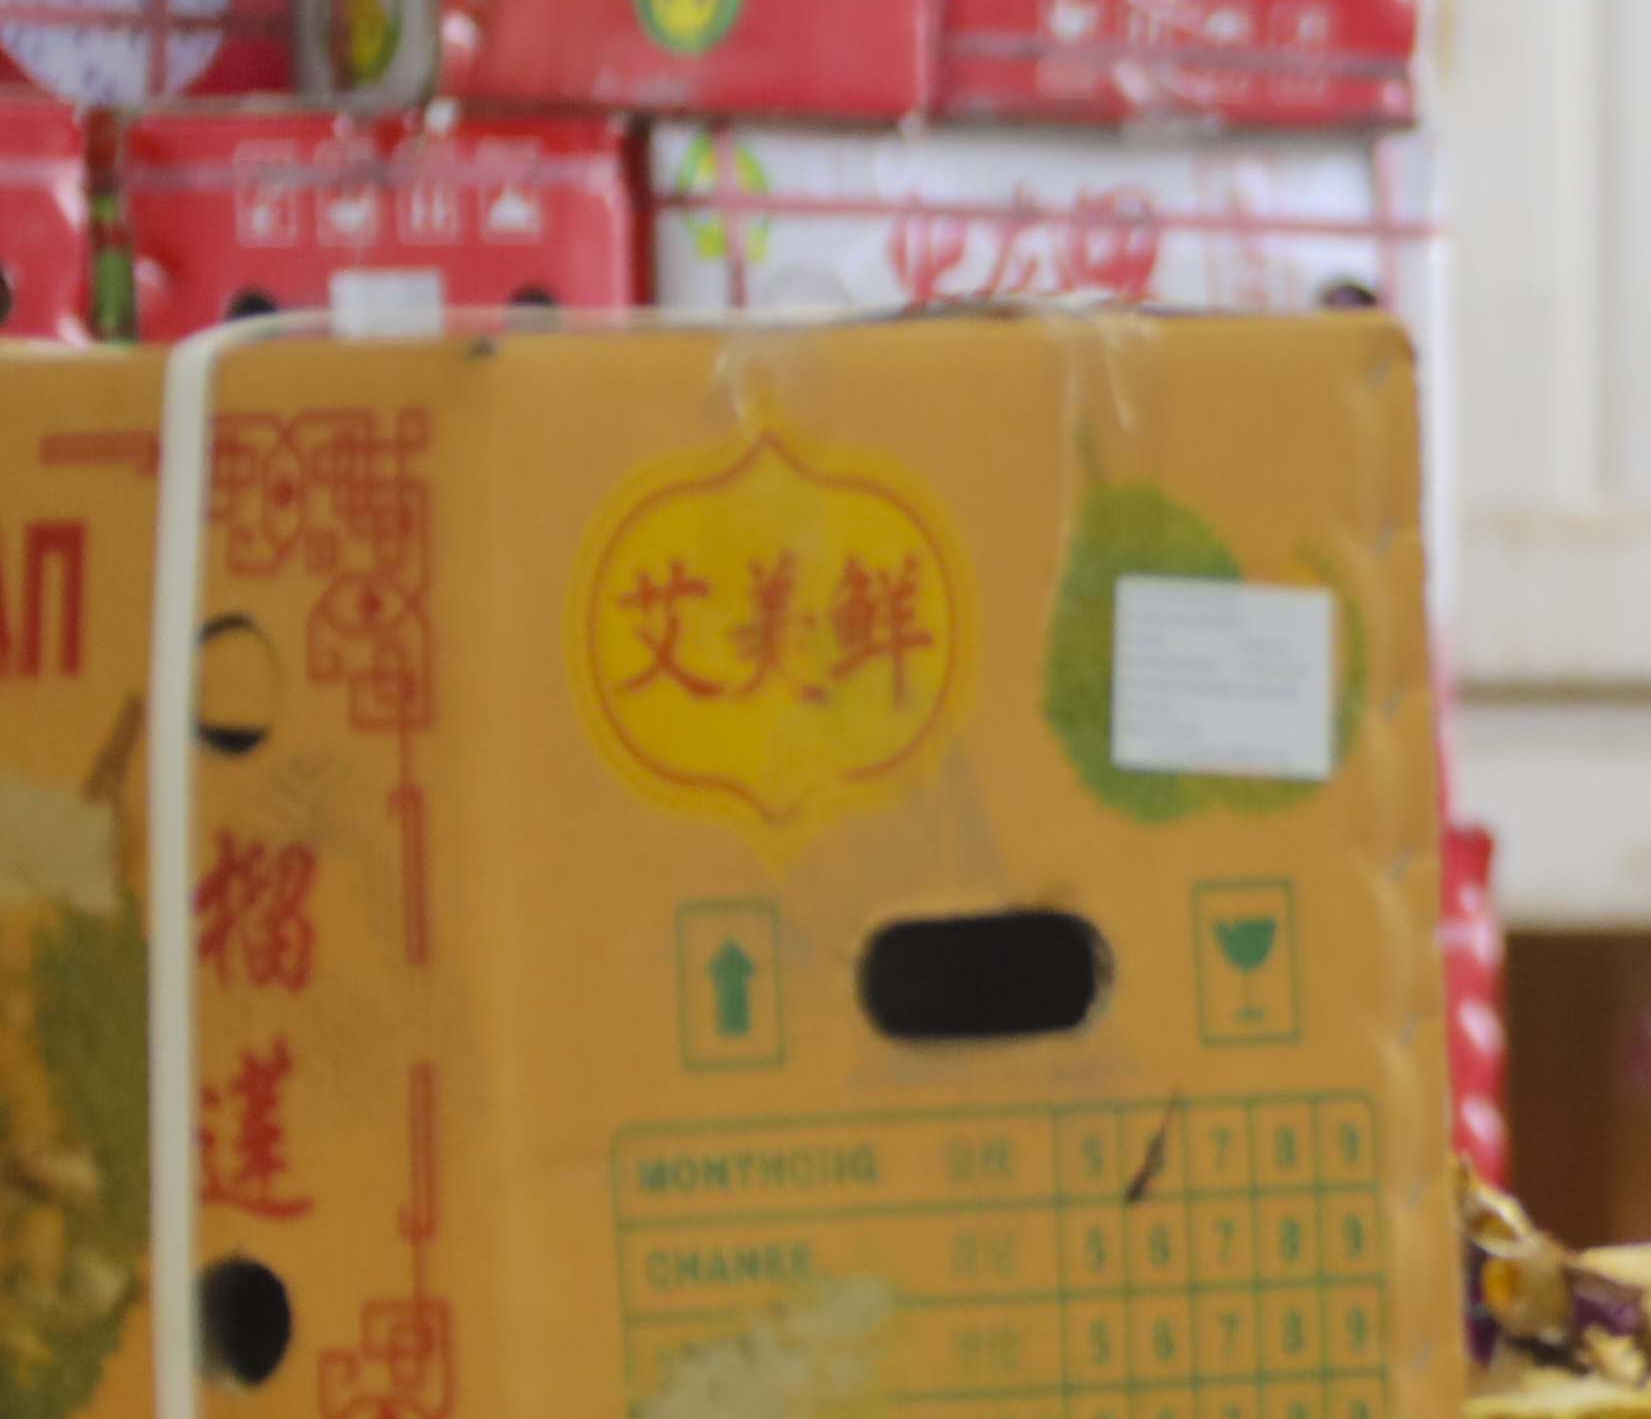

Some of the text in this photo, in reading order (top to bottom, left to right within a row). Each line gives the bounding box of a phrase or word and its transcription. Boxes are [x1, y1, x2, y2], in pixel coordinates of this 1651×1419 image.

[1084, 1133, 1103, 1177] 5
[1211, 1125, 1229, 1171] 7
[1275, 1123, 1296, 1169] 8
[1340, 1120, 1360, 1163] 9
[1085, 1226, 1106, 1271] 5
[1150, 1222, 1172, 1267] 6
[1215, 1218, 1236, 1262] 7
[1279, 1217, 1301, 1262] 8
[1343, 1213, 1365, 1259] 9
[1090, 1307, 1368, 1366] 5 6 7 8 9
